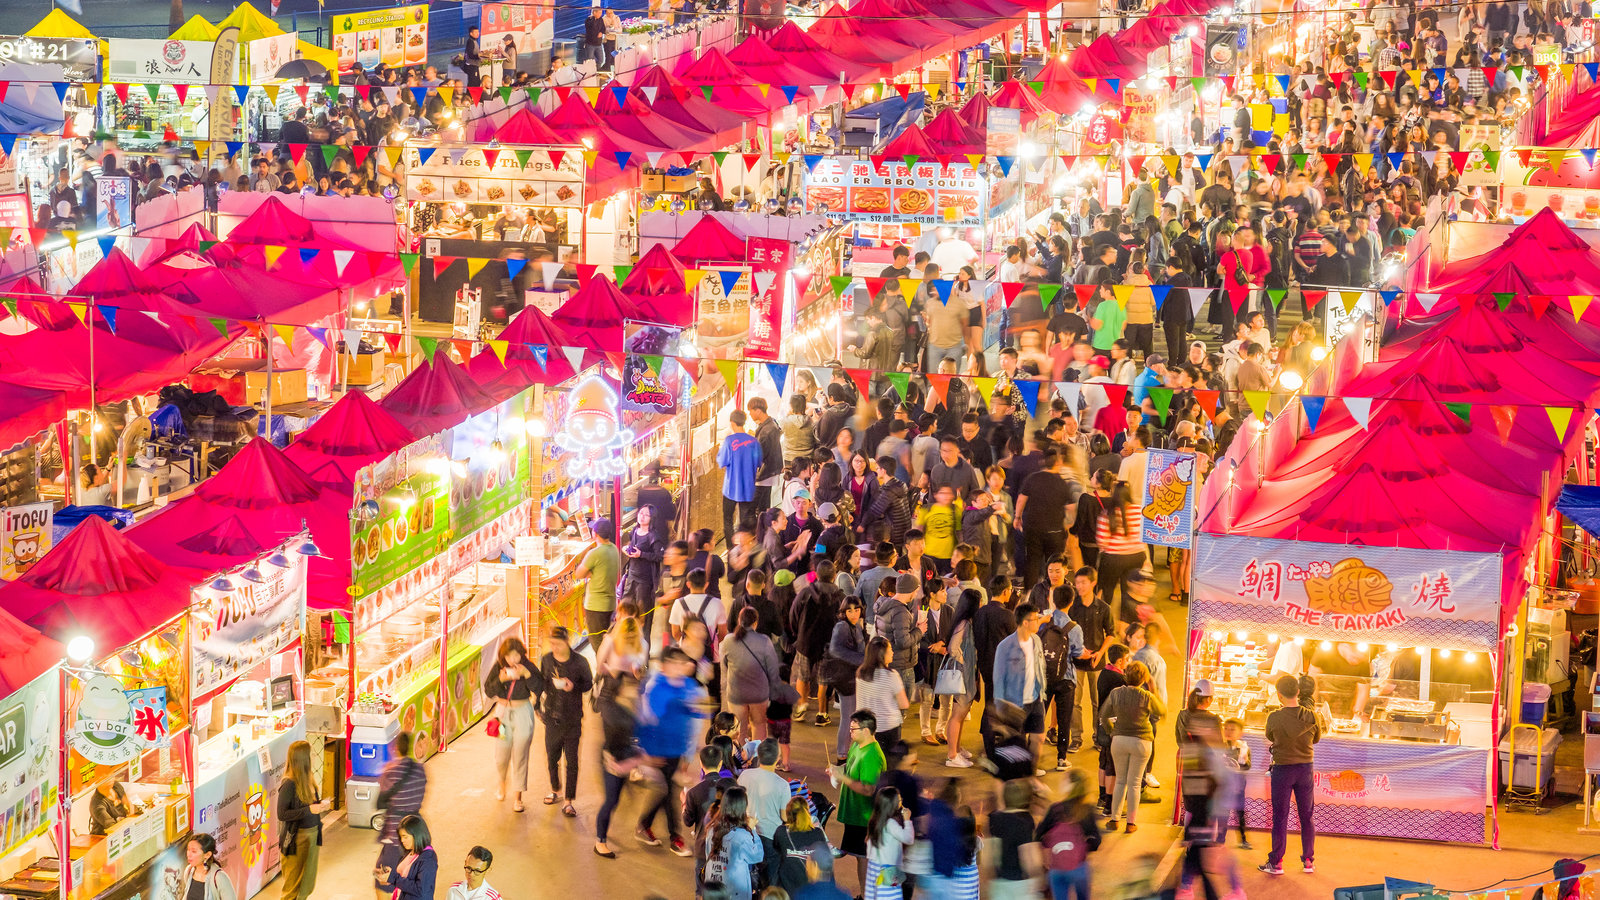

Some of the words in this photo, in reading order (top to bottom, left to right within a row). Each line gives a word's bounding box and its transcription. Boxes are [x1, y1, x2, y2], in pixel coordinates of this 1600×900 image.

[358, 16, 384, 26] RECYCLING
[1535, 53, 1559, 63] BBQ
[145, 59, 161, 75] 浪
[187, 62, 202, 77] 人
[1125, 92, 1154, 103] Tako
[442, 156, 481, 167] Fies
[500, 158, 552, 171] Thngs
[870, 215, 892, 223] $12.00
[914, 216, 935, 224] $13.00
[752, 247, 784, 263] 正宗
[7, 510, 48, 531] iTOFU
[1145, 529, 1159, 540] THE
[1161, 533, 1187, 543] TAIYAKI
[1287, 560, 1333, 581] たいやき
[1237, 559, 1282, 602] 鯛
[1411, 571, 1456, 613] 燒
[1284, 602, 1323, 627] THE
[1331, 607, 1407, 632] TAIYAKI
[106, 721, 127, 734] bar
[1322, 787, 1337, 797] THE
[1340, 790, 1370, 799] TAIYAKI
